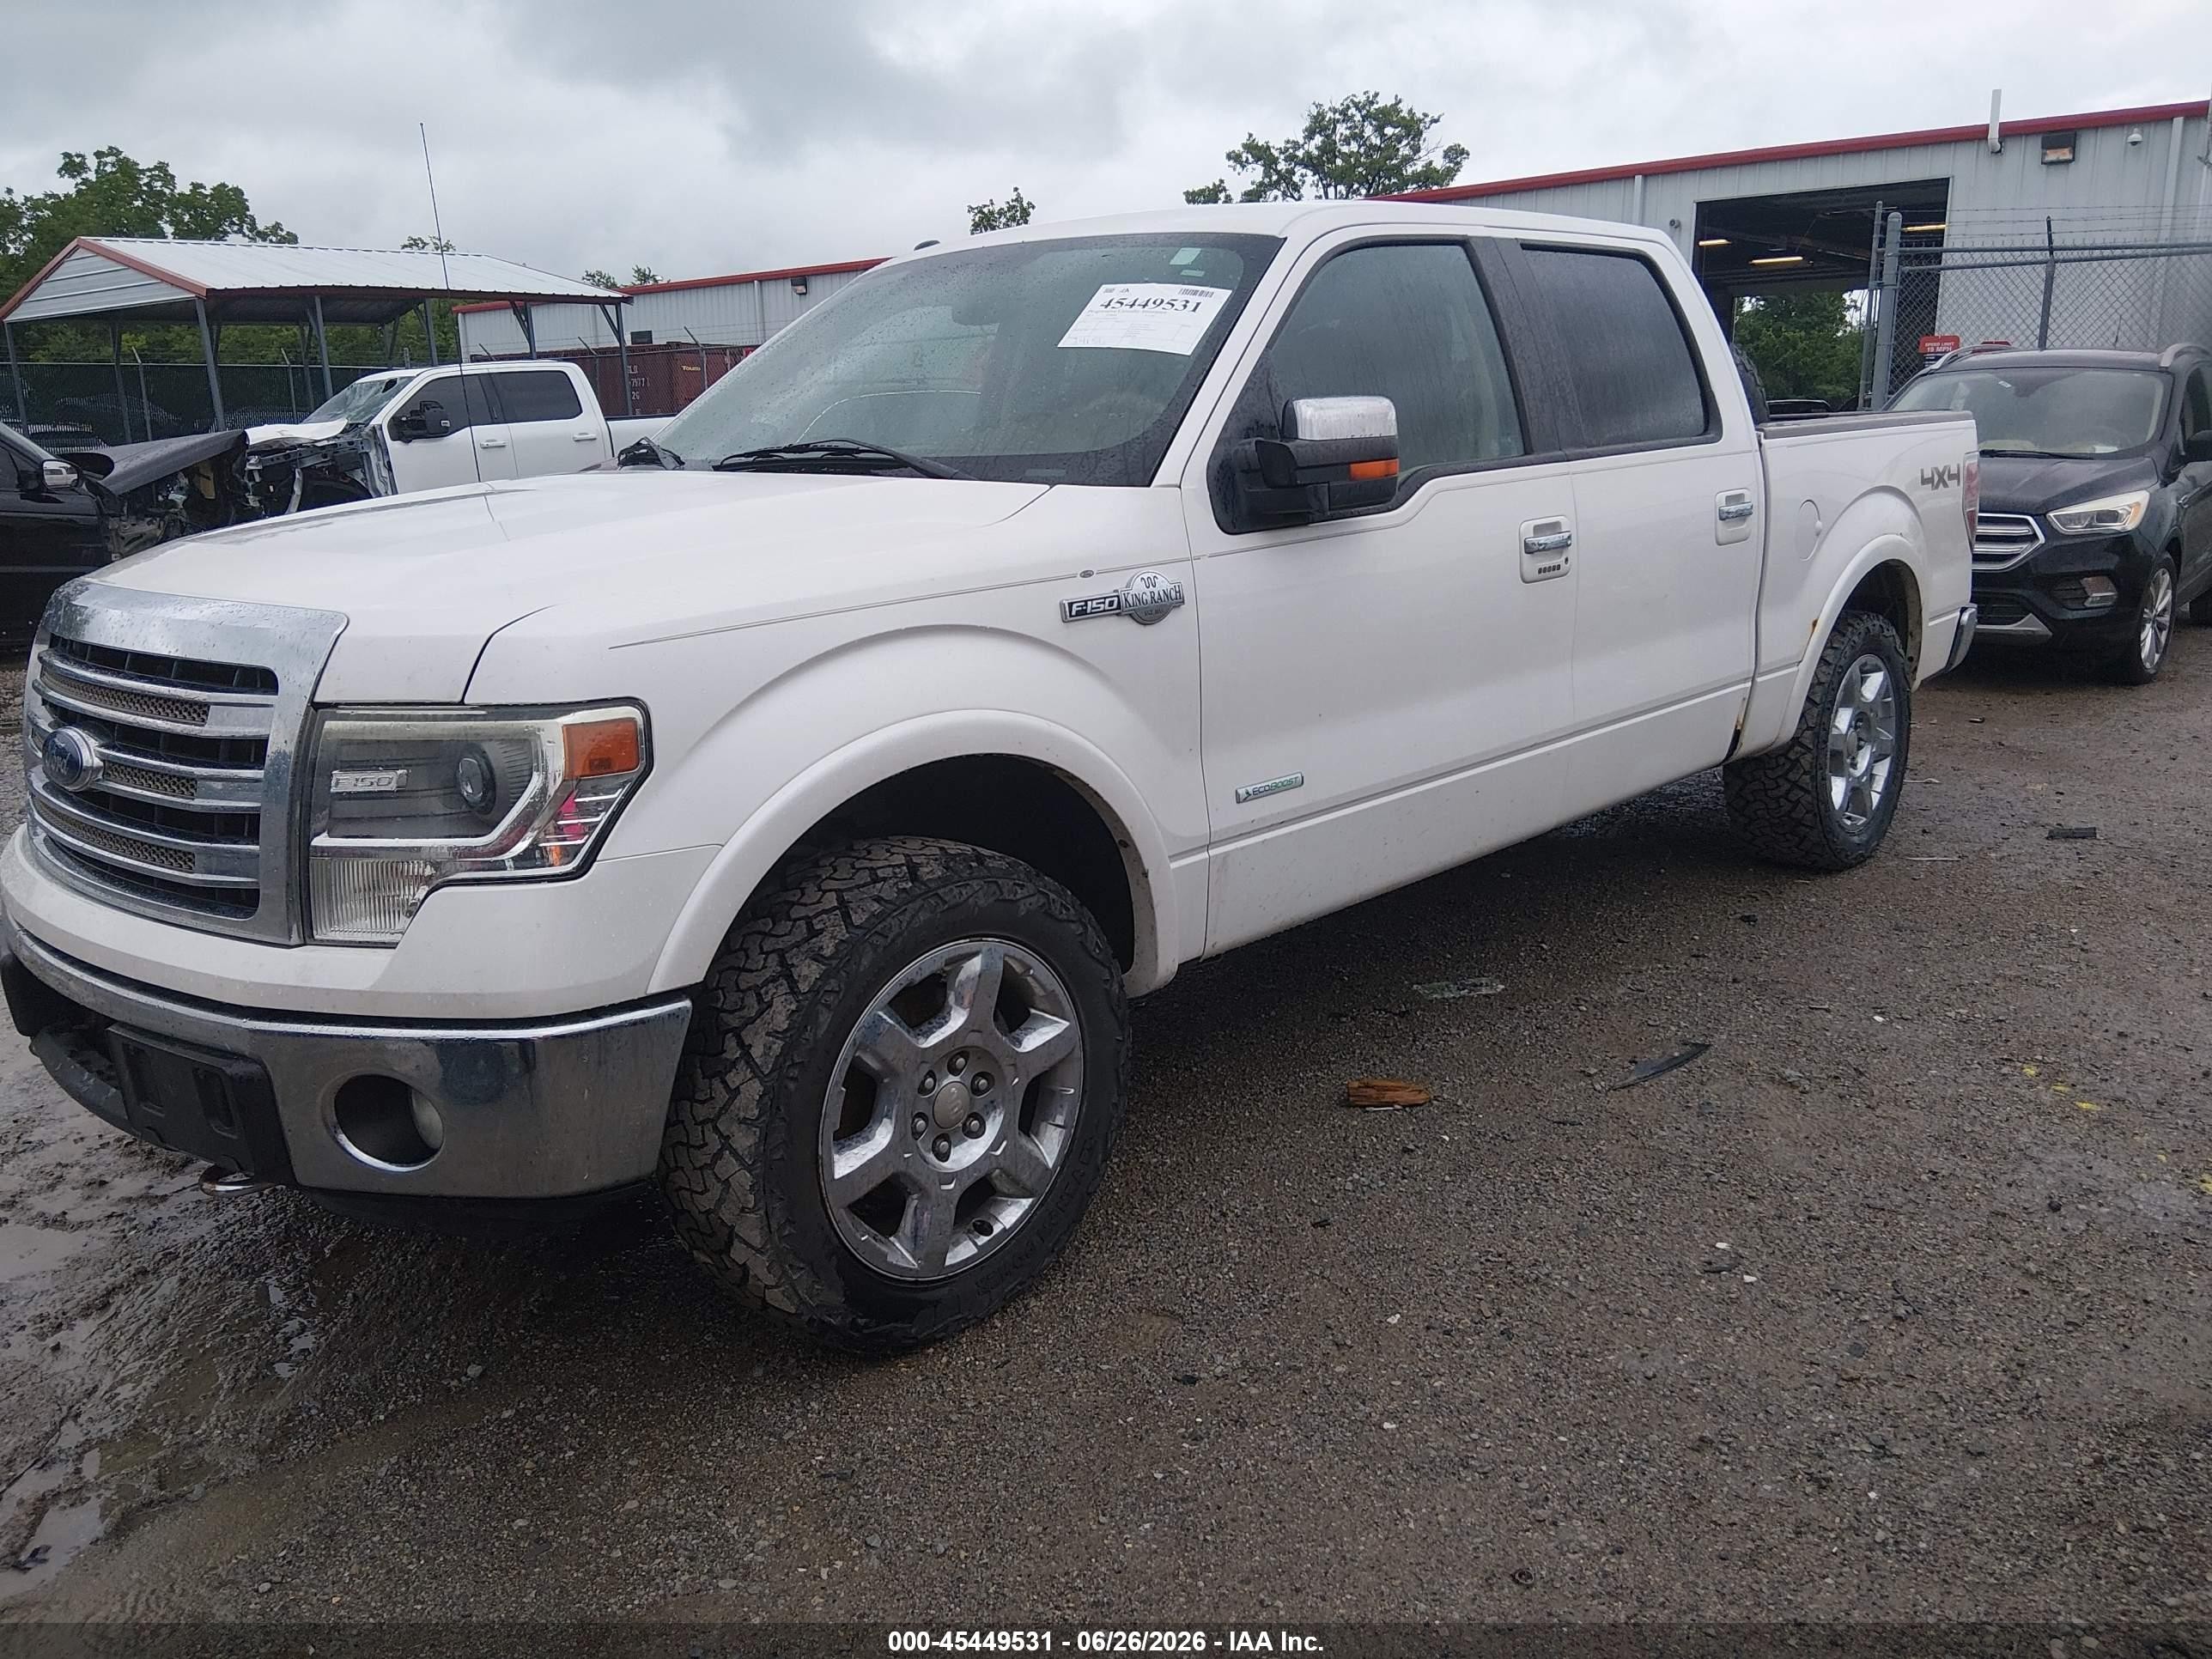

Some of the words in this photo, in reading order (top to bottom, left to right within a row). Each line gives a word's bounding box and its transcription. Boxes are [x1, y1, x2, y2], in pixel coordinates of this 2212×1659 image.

[1100, 297, 1201, 313] 45449531
[1121, 591, 1149, 610] KING
[1150, 584, 1182, 604] RANCH
[45, 740, 71, 775] Ford
[1252, 776, 1299, 795] ECOBOOST
